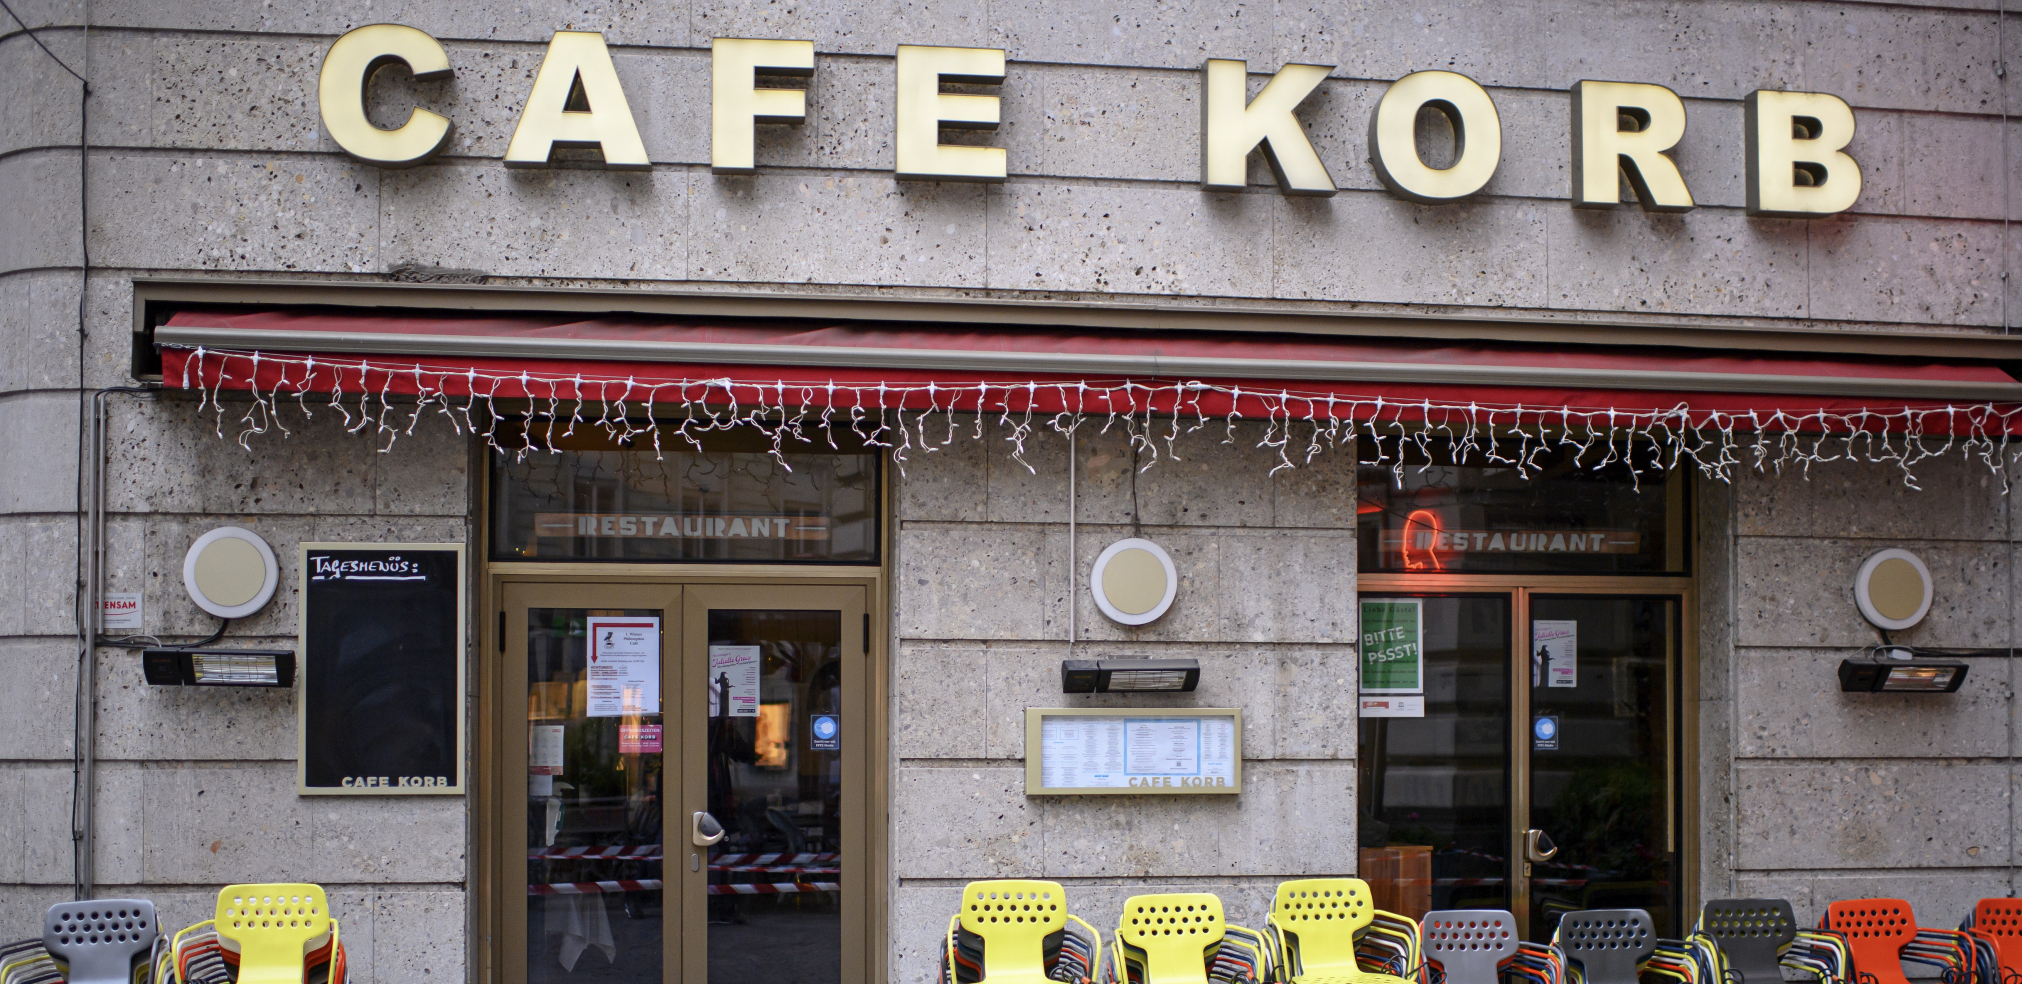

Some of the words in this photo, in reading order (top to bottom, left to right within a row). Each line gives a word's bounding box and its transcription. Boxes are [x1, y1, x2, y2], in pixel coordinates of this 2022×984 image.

[319, 23, 1006, 183] CAFE
[1202, 58, 1862, 218] KORB
[578, 515, 792, 538] RESTAURANT
[1415, 530, 1606, 552] RESTAURANT
[1364, 626, 1405, 647] BITTE
[1368, 642, 1418, 665] PSSST!
[341, 775, 390, 787] CAFE
[398, 775, 448, 787] KORB
[1128, 776, 1172, 788] CAFE
[1181, 776, 1226, 788] KORB
